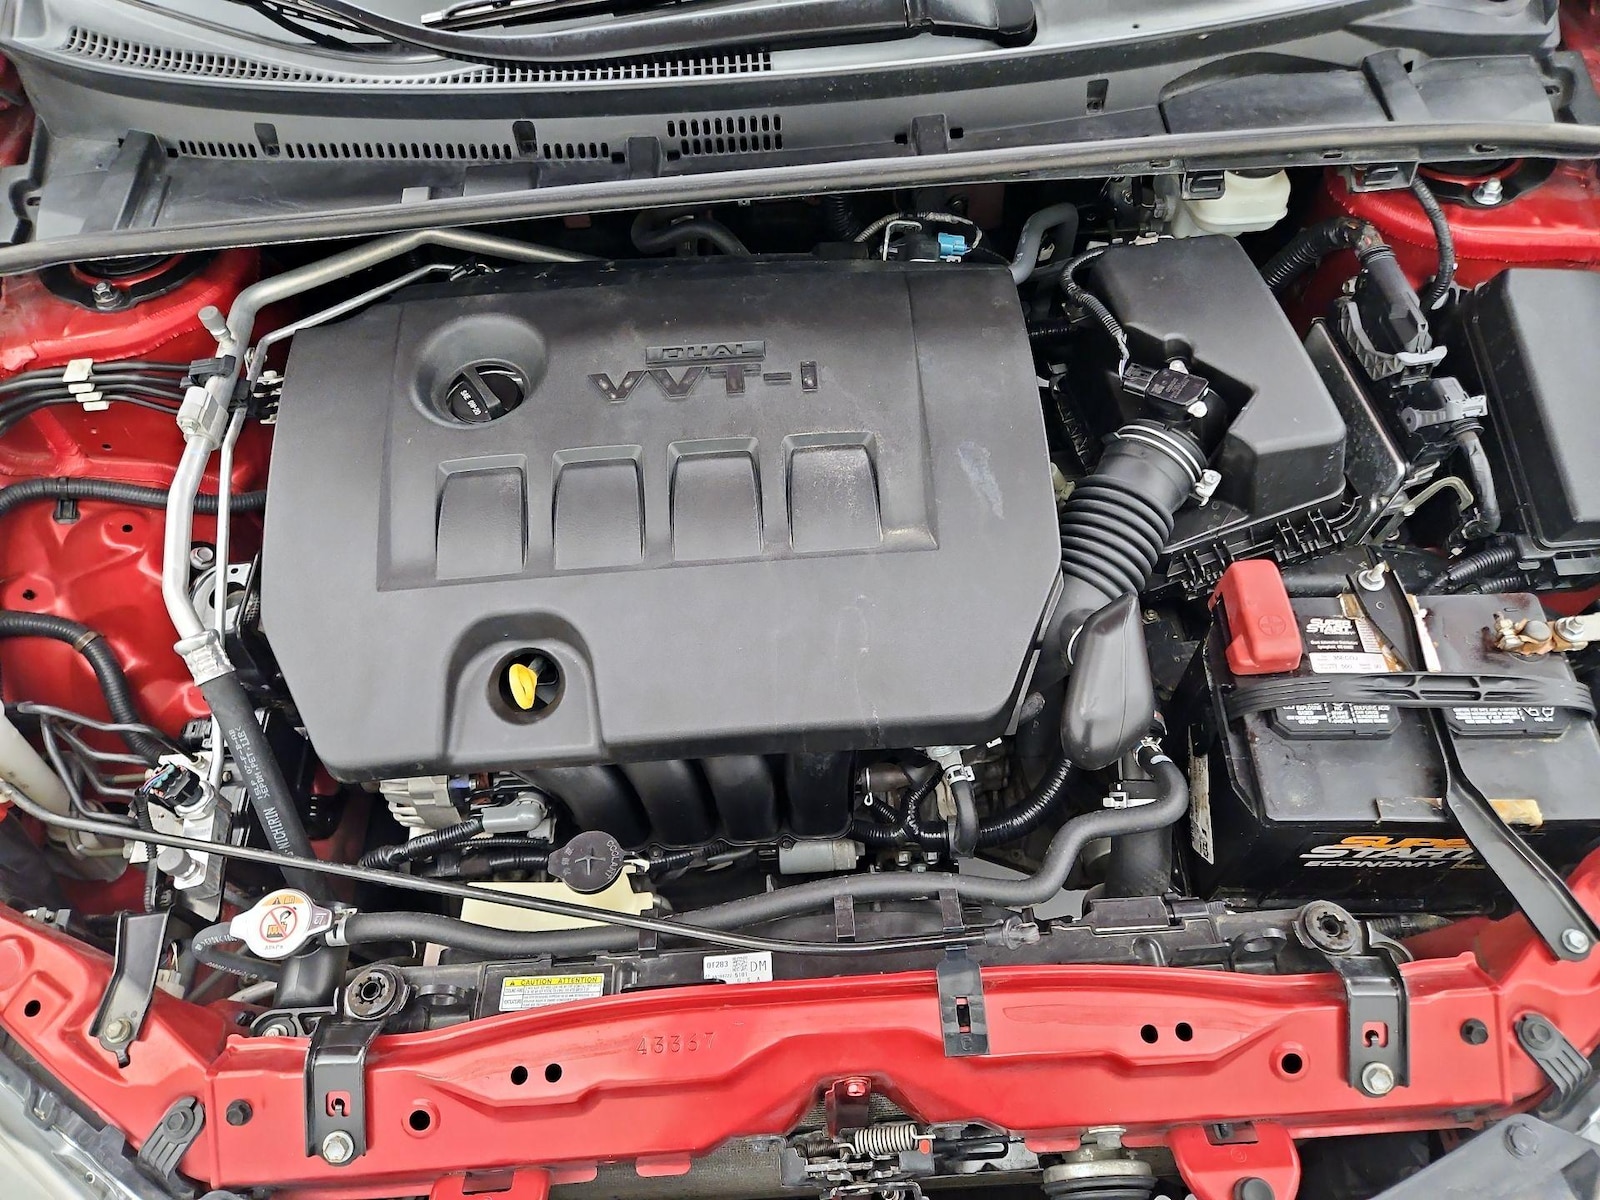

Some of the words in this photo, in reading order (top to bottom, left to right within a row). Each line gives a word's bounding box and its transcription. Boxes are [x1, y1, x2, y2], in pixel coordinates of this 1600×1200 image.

[661, 343, 755, 359] DUAL
[1310, 618, 1351, 626] SUPER
[606, 840, 620, 880] COOLANT
[1304, 860, 1446, 868] ECONOMY
[750, 960, 767, 972] DM
[558, 976, 598, 984] ATTENTION
[636, 1032, 715, 1055] 43367
